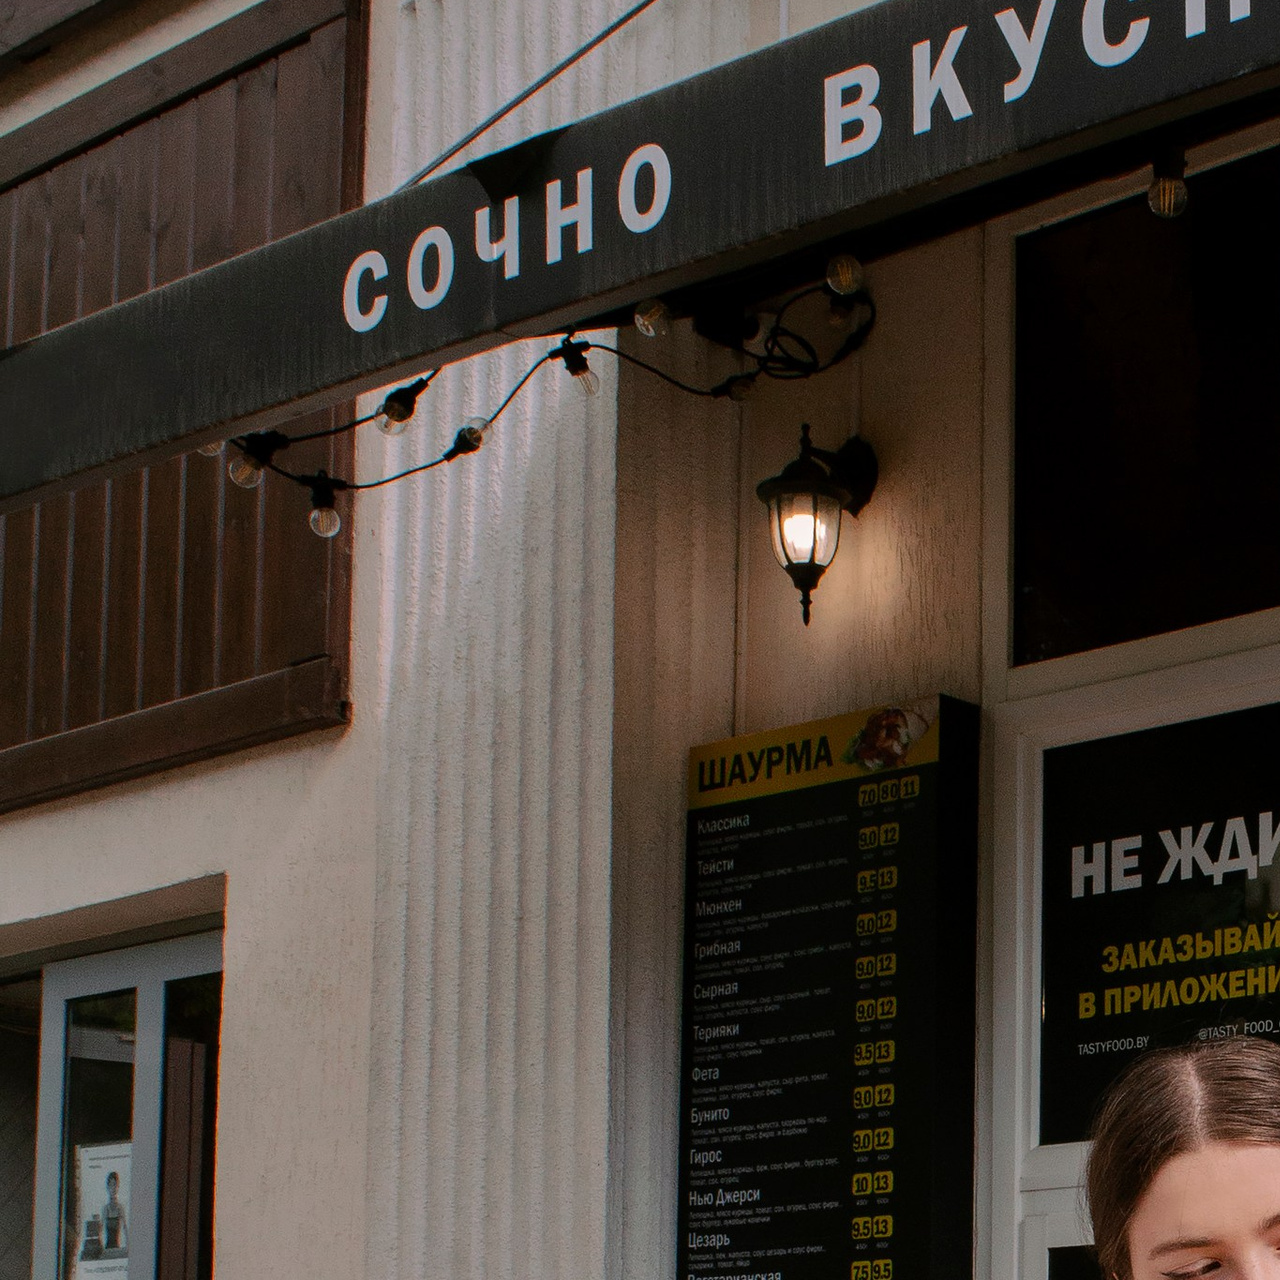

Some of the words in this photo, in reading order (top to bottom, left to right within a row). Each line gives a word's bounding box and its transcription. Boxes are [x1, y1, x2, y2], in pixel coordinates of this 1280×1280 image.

[343, 142, 672, 333] СОЧНО
[698, 736, 833, 792] ШАУРМА
[904, 780, 914, 795] 11
[697, 813, 749, 835] Классика
[884, 826, 896, 842] 12
[697, 857, 734, 876] Тейсти
[1070, 835, 1143, 899] НЕ
[860, 873, 876, 890] 9.5
[880, 869, 892, 886] 13
[695, 898, 742, 917] Мюнхен
[858, 917, 874, 934] 9.0
[878, 912, 891, 928] 12
[694, 939, 740, 960] Грибная
[857, 959, 873, 976] 9.0
[879, 955, 892, 971] 12
[693, 981, 738, 1001] Сырная
[858, 1003, 873, 1020] 9.0
[880, 1000, 892, 1015] 12
[1078, 992, 1096, 1020] В
[693, 1022, 739, 1044] Терияки
[856, 1044, 872, 1060] 9.5
[876, 1042, 889, 1059] 13
[1078, 1036, 1150, 1056] TASTYFOOD.BY
[691, 1067, 719, 1081] Фета
[854, 1090, 870, 1106] 9.0
[877, 1087, 890, 1103] 12
[690, 1107, 729, 1126] Бунито
[853, 1133, 870, 1149] 9.0
[876, 1131, 888, 1146] 12
[690, 1148, 722, 1168] Гирос
[855, 1176, 867, 1192] 10
[875, 1175, 887, 1190] 13
[689, 1188, 713, 1205] Нью
[715, 1187, 760, 1206] Джерси
[853, 1220, 869, 1236] 9.5
[875, 1218, 887, 1234] 13
[688, 1231, 730, 1250] Цезарь
[873, 1263, 890, 1279] 9.5
